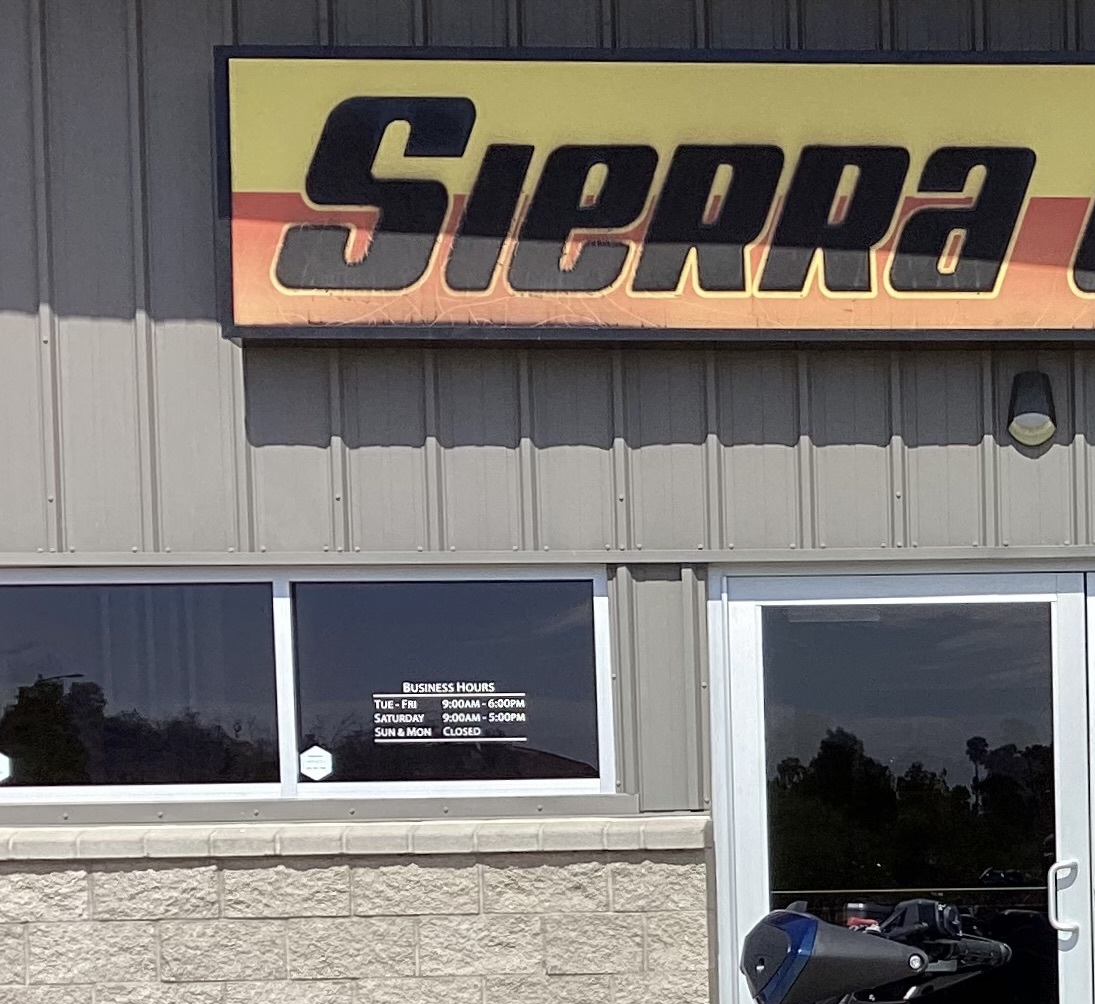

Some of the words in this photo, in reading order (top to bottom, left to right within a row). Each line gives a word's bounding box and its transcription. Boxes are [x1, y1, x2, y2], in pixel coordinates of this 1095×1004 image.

[402, 682, 454, 693] BUSINESS
[456, 682, 495, 692] HOURS
[374, 699, 394, 709] TUE
[401, 699, 417, 709] FRI
[442, 699, 481, 709] 9:00AM
[487, 699, 525, 708] 6:00PM
[374, 713, 425, 723] SATURDAY
[442, 713, 481, 722] 9:00AM
[488, 712, 526, 722] 5:00PM
[374, 727, 398, 737] SUN
[397, 727, 406, 737] &
[406, 727, 432, 737] MON
[442, 727, 481, 737] CLOSED
